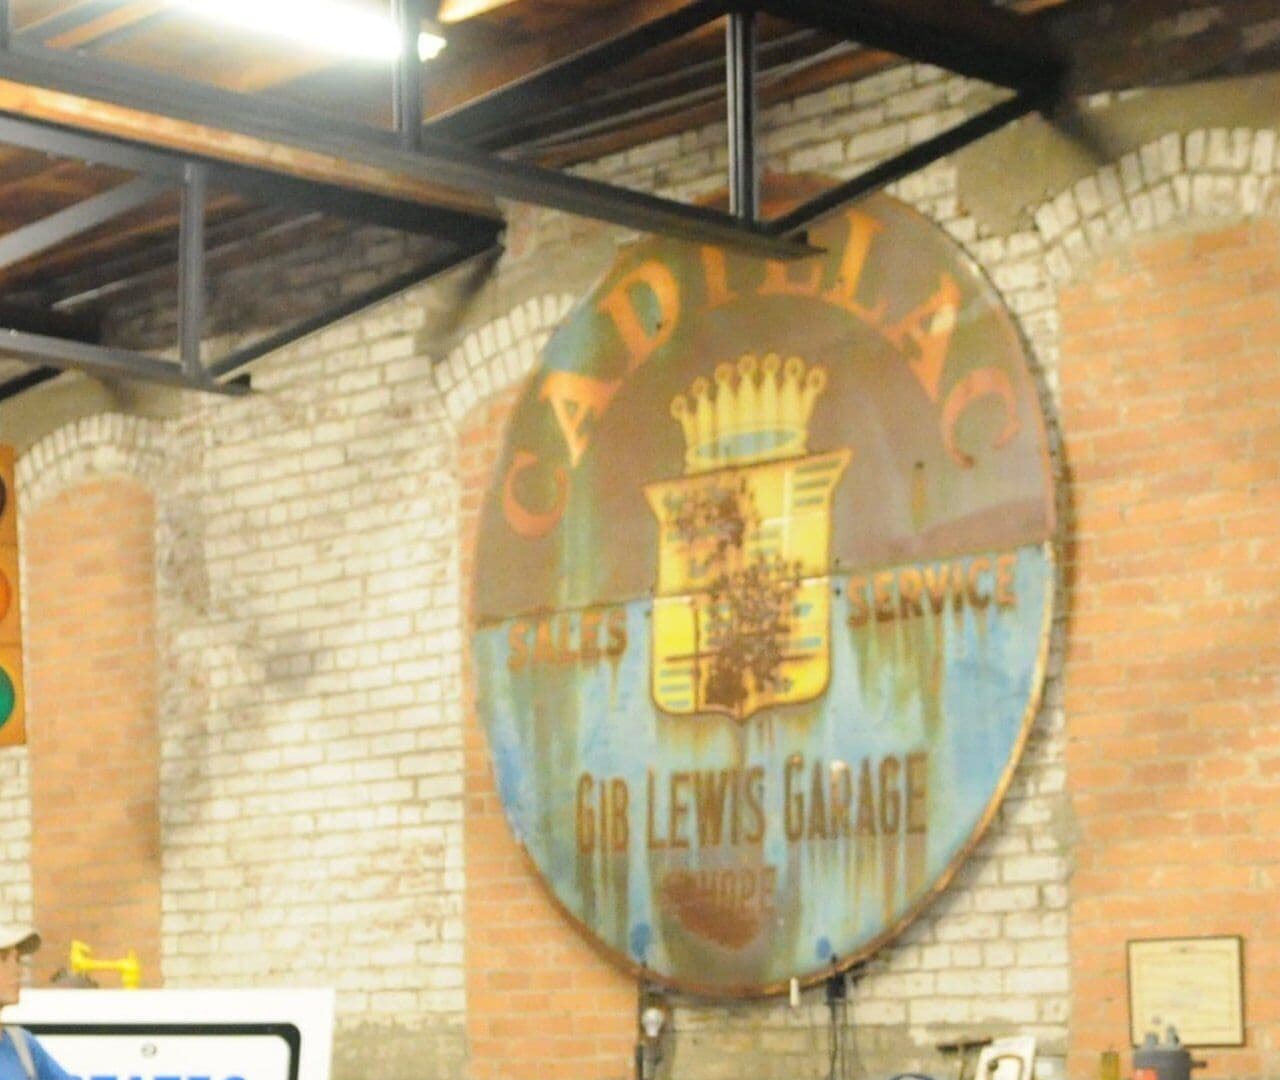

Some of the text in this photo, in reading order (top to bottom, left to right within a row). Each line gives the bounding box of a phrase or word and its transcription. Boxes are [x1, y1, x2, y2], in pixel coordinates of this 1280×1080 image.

[507, 554, 1018, 672] SALES SERVICE
[575, 750, 929, 854] GIB LEWIS GARAGE
